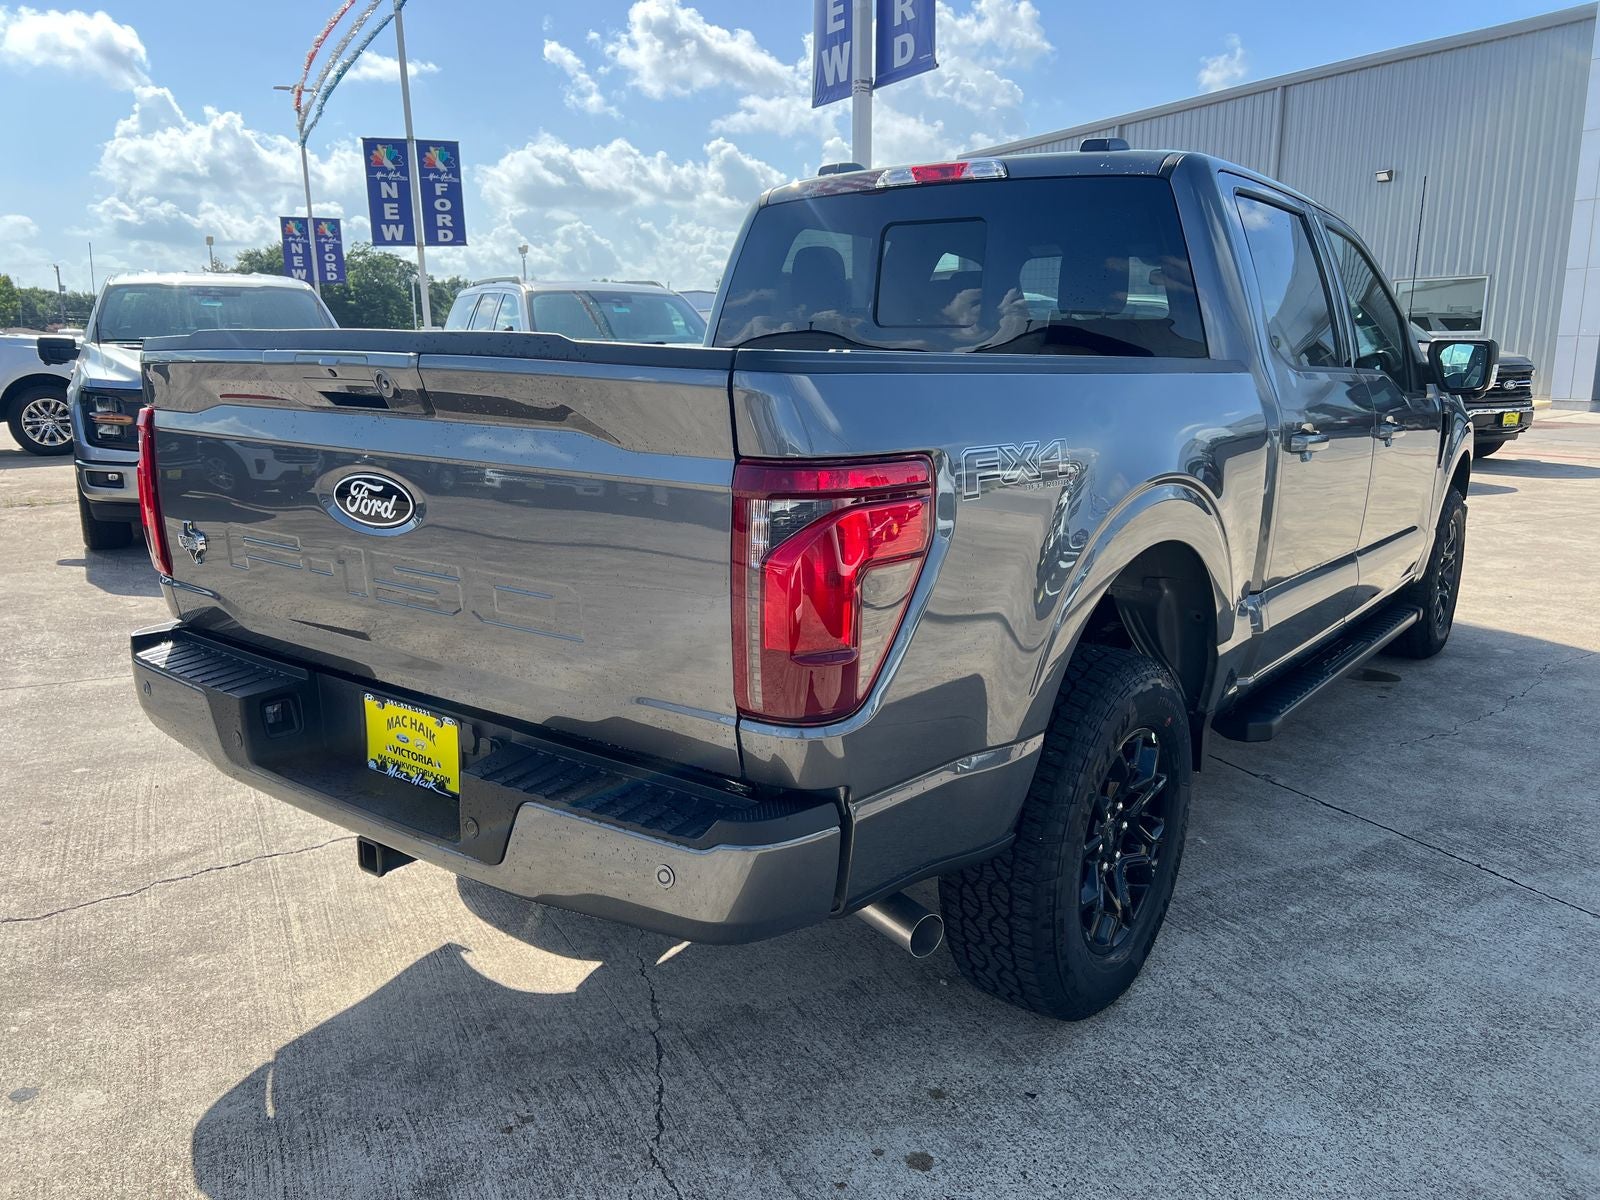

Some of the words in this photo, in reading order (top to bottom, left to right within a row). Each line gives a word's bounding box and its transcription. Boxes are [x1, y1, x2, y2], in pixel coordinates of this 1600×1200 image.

[380, 182, 404, 241] NEW
[434, 183, 454, 242] FORD
[291, 243, 307, 280] NEW
[324, 244, 338, 281] FORD
[960, 438, 1070, 501] FX4
[346, 480, 397, 519] Ford
[386, 715, 407, 731] MAC
[410, 717, 437, 746] HAIK
[392, 745, 434, 768] VICTORIA
[385, 763, 410, 782] Mac
[411, 773, 438, 791] Haik
